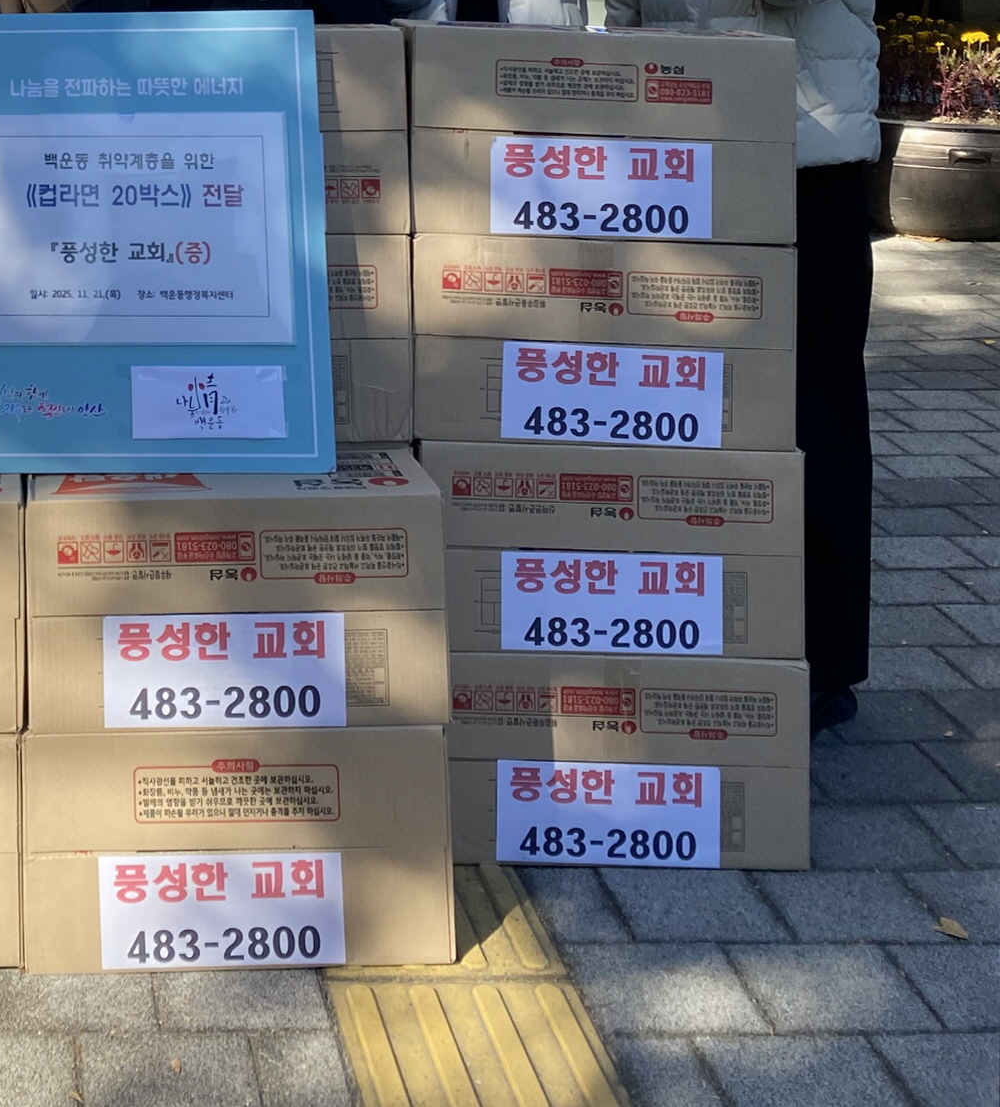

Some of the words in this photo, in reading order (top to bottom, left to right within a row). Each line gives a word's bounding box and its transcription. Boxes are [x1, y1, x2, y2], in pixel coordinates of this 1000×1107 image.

[661, 64, 685, 75] 농심
[9, 78, 59, 98] 나눔을
[64, 78, 131, 97] 전파하는
[137, 77, 187, 96] 따뜻한
[193, 76, 244, 95] 에너지
[660, 88, 711, 97] 080-023-5181
[44, 153, 89, 171] 백운동
[98, 152, 175, 170] 취약계층을
[184, 152, 215, 170] 위한
[504, 143, 607, 180] 풍성한
[628, 148, 693, 181] 교회
[202, 183, 244, 208] 전달
[514, 201, 689, 231] 483-2800
[551, 277, 606, 287] 080-023-5181
[160, 289, 234, 300] 백운동행정복지센터
[580, 302, 607, 312] 농심
[517, 350, 618, 385] 풍성한
[639, 355, 705, 390] 교회
[77, 402, 107, 418] 안산
[194, 415, 224, 431] 백운동
[523, 406, 699, 442] 483-2800
[561, 482, 616, 491] 080-023-5181
[590, 507, 616, 518] 농심
[177, 541, 237, 551] 080-023-5181
[210, 569, 238, 581] 농심
[516, 559, 617, 594] 풍성한
[639, 562, 704, 595] 교회
[117, 621, 230, 662] 풍성한
[253, 621, 325, 658] 교회
[524, 617, 699, 648] 483-2800
[131, 685, 321, 718] 483-2800
[563, 695, 619, 704] 080-023-5181
[592, 721, 619, 732] 농심
[217, 761, 254, 771] 주의사항
[512, 768, 614, 804] 풍성한
[636, 772, 701, 806] 교회
[519, 826, 696, 861] 483-2800
[113, 861, 229, 904] 풍성한
[250, 859, 325, 899] 교회
[128, 925, 320, 963] 483-2800
